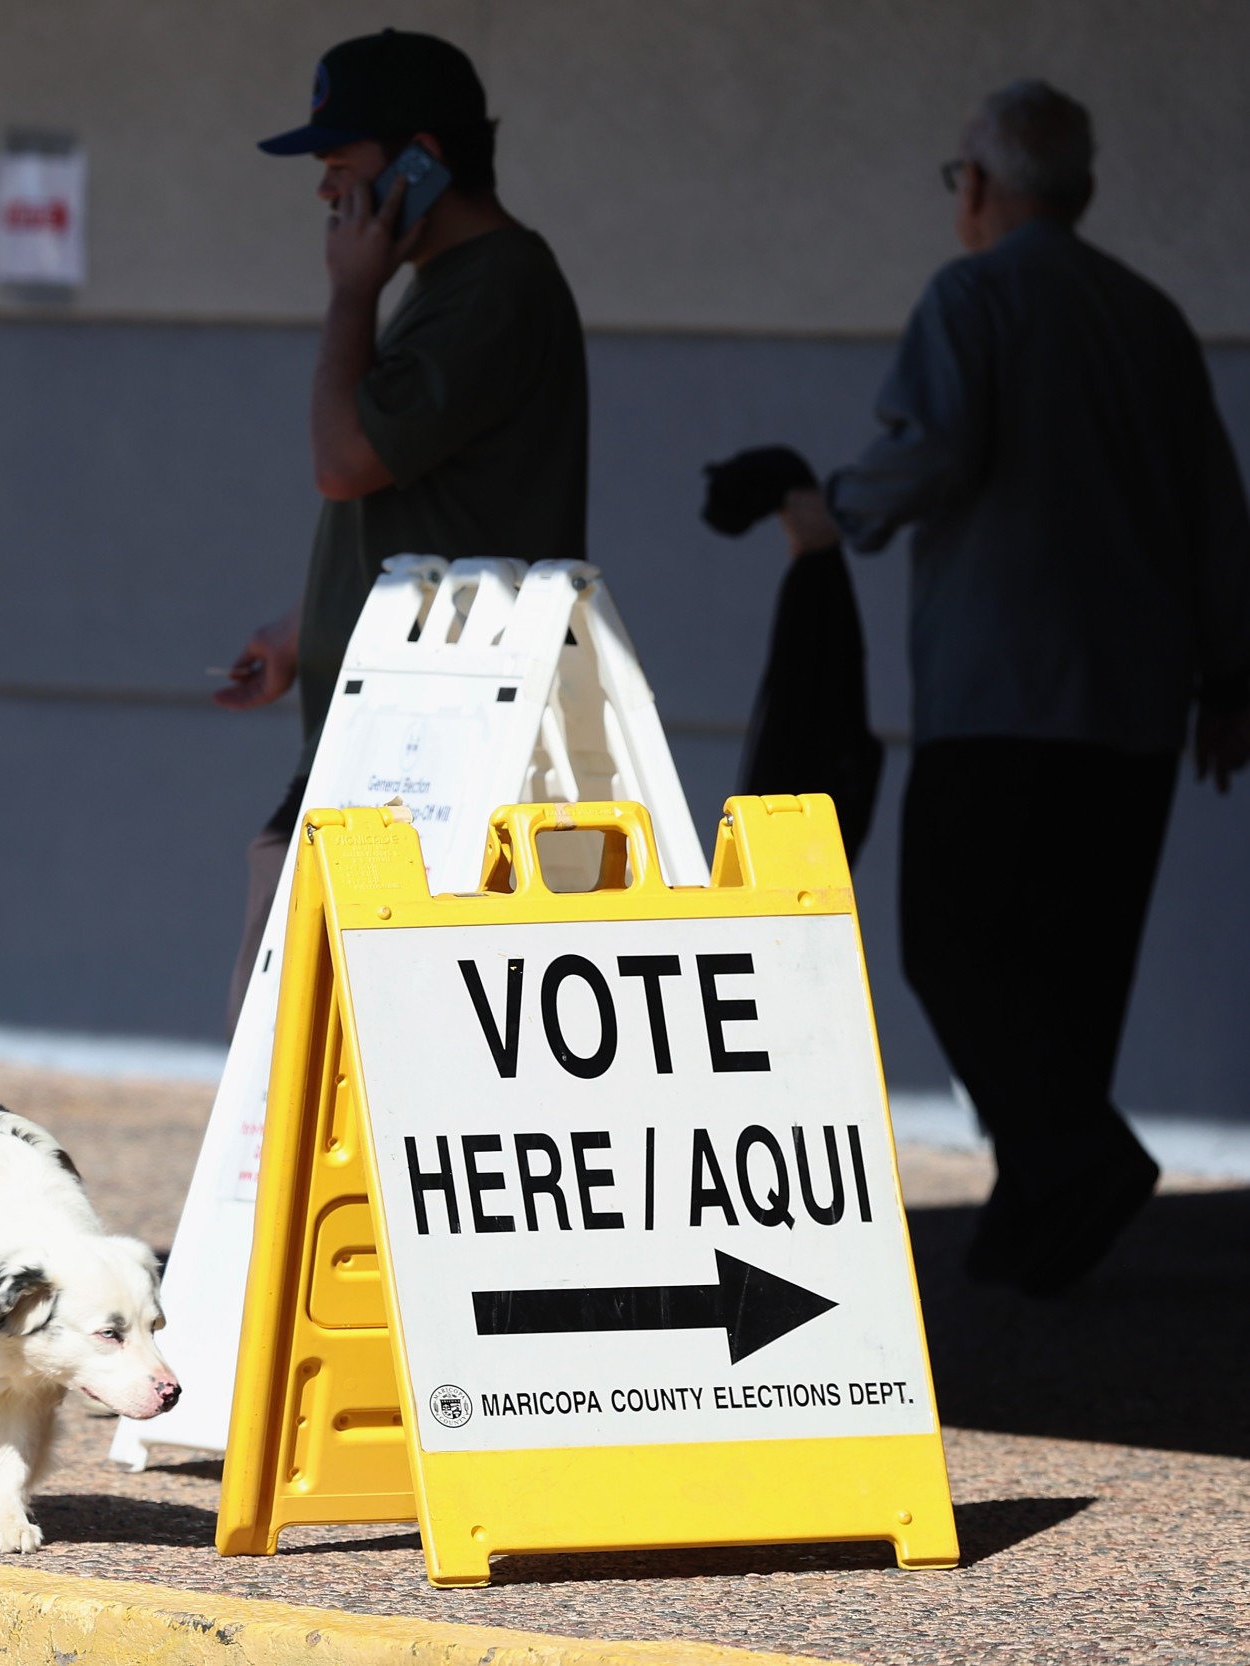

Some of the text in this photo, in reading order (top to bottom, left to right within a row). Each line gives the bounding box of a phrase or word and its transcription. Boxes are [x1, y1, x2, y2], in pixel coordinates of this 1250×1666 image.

[457, 953, 771, 1079] VOTE
[404, 1131, 625, 1235] HERE
[689, 1123, 873, 1231] AQUI
[433, 1387, 465, 1400] MARICOPA
[481, 1382, 914, 1416] MARICOPA COUNTY ELECTIONS DEPT.
[439, 1416, 467, 1425] COUNTY
